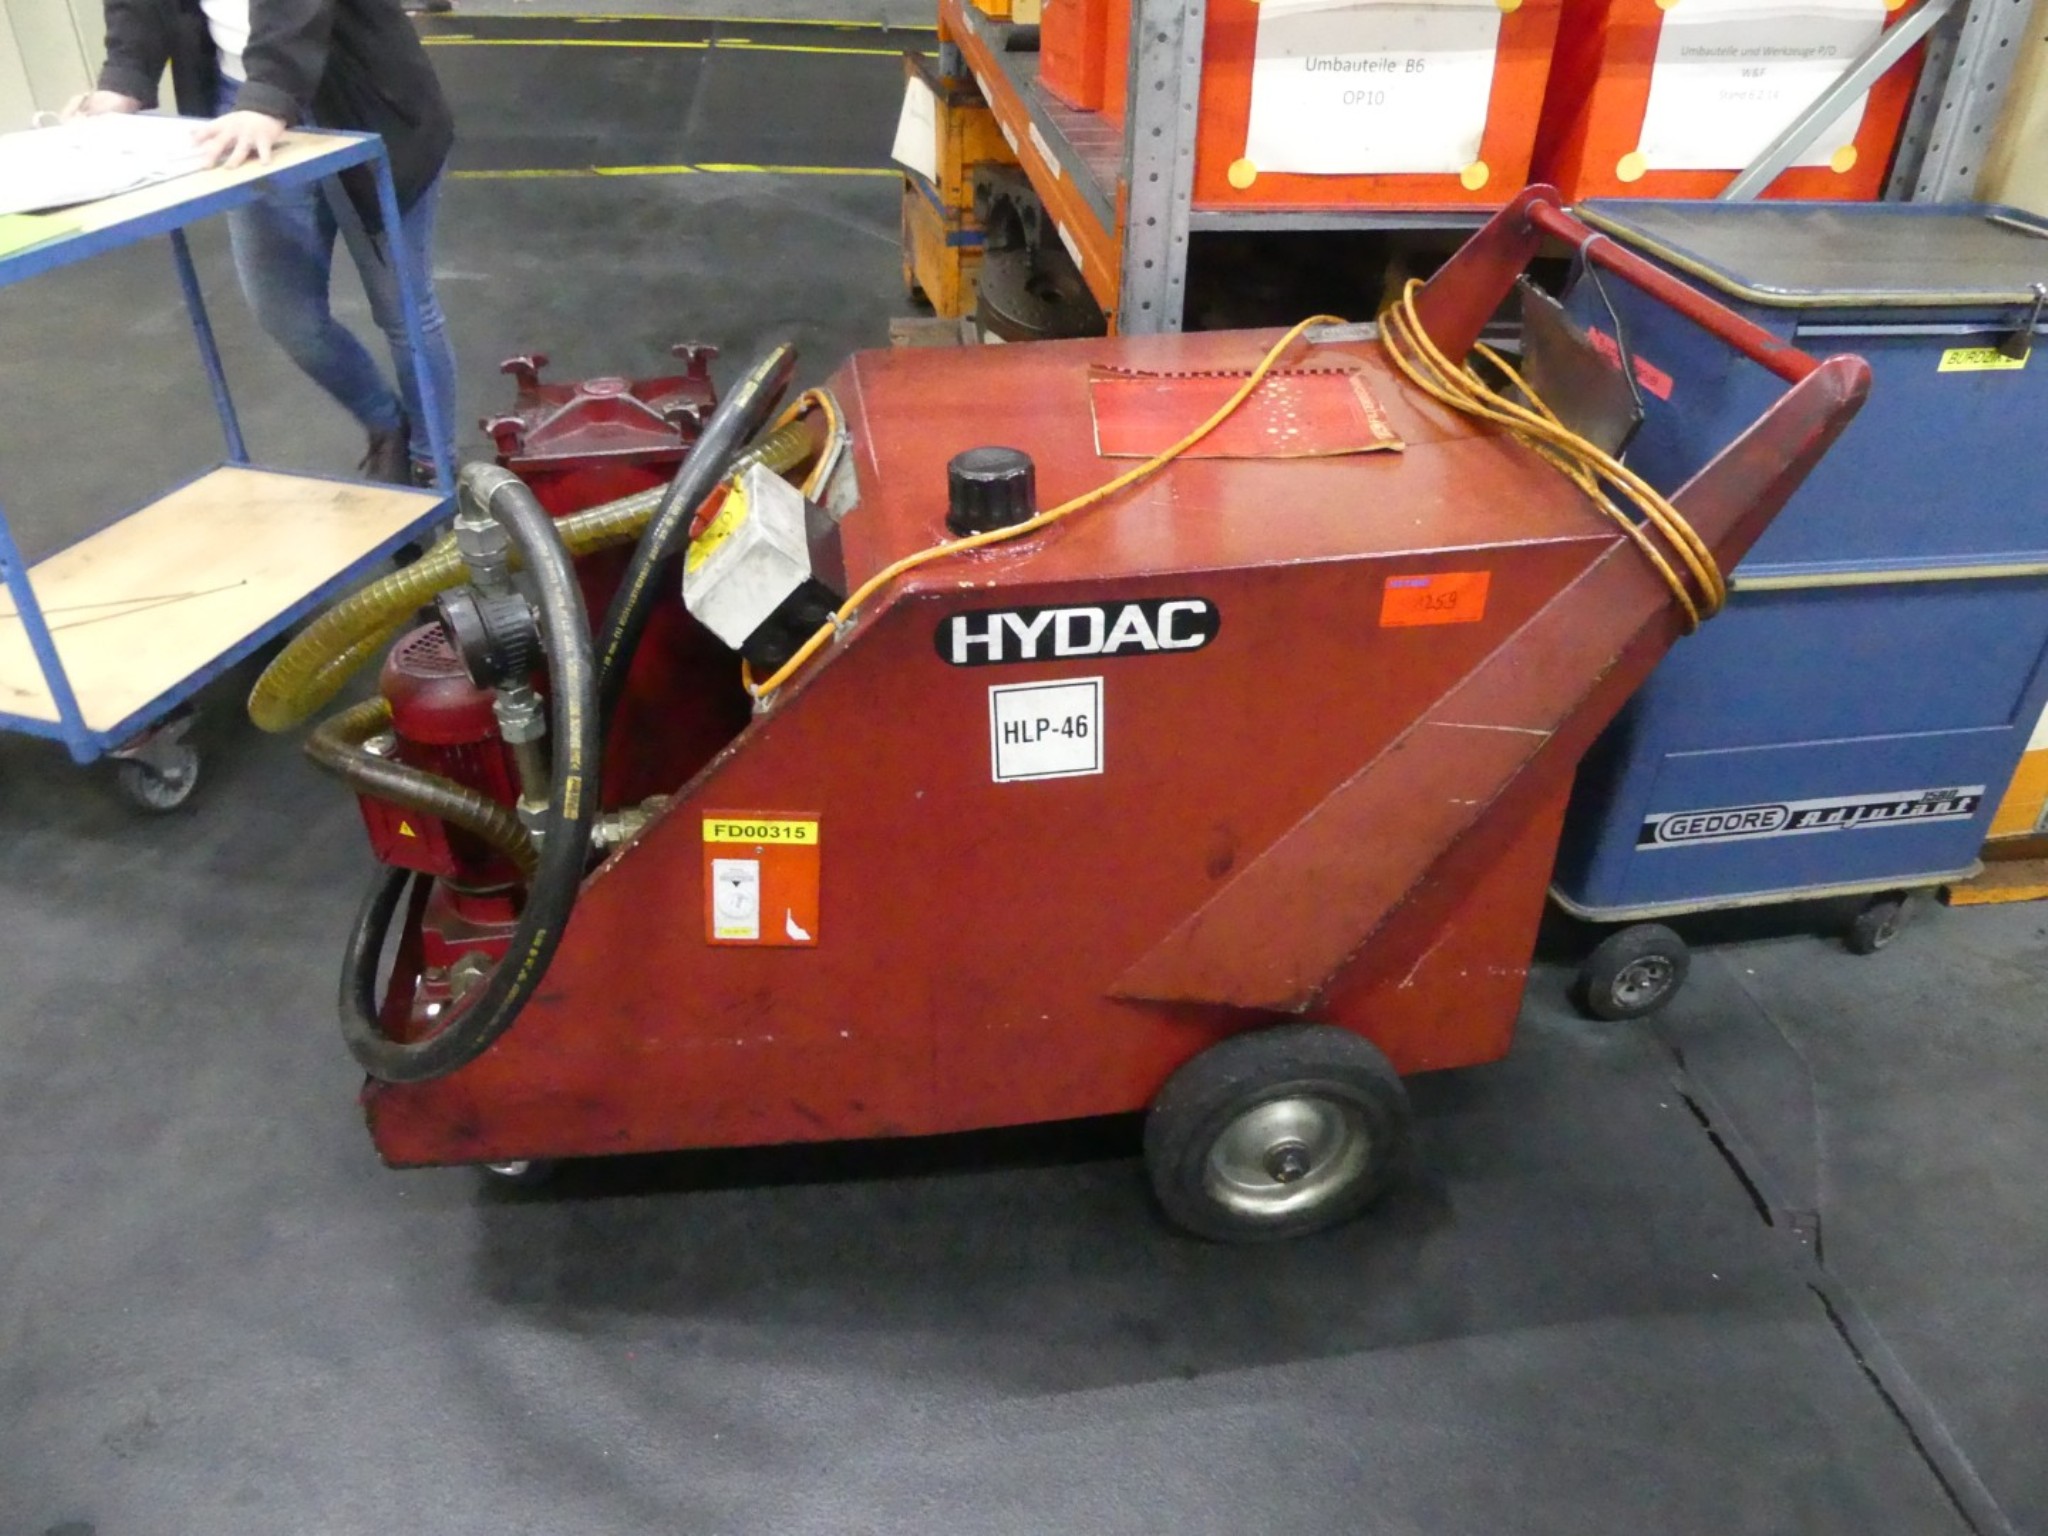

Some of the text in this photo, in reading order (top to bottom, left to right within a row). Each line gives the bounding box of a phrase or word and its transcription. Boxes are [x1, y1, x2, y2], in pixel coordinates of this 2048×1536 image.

[1680, 45, 1738, 57] Umbauteile
[1740, 46, 1761, 57] und
[1306, 56, 1425, 73] Umbauteile B6
[1343, 90, 1385, 106] OP10
[951, 600, 1207, 664] HYDAC
[1003, 714, 1088, 745] HLP-46
[714, 824, 806, 839] FD00315
[1669, 810, 1779, 836] GEDORE
